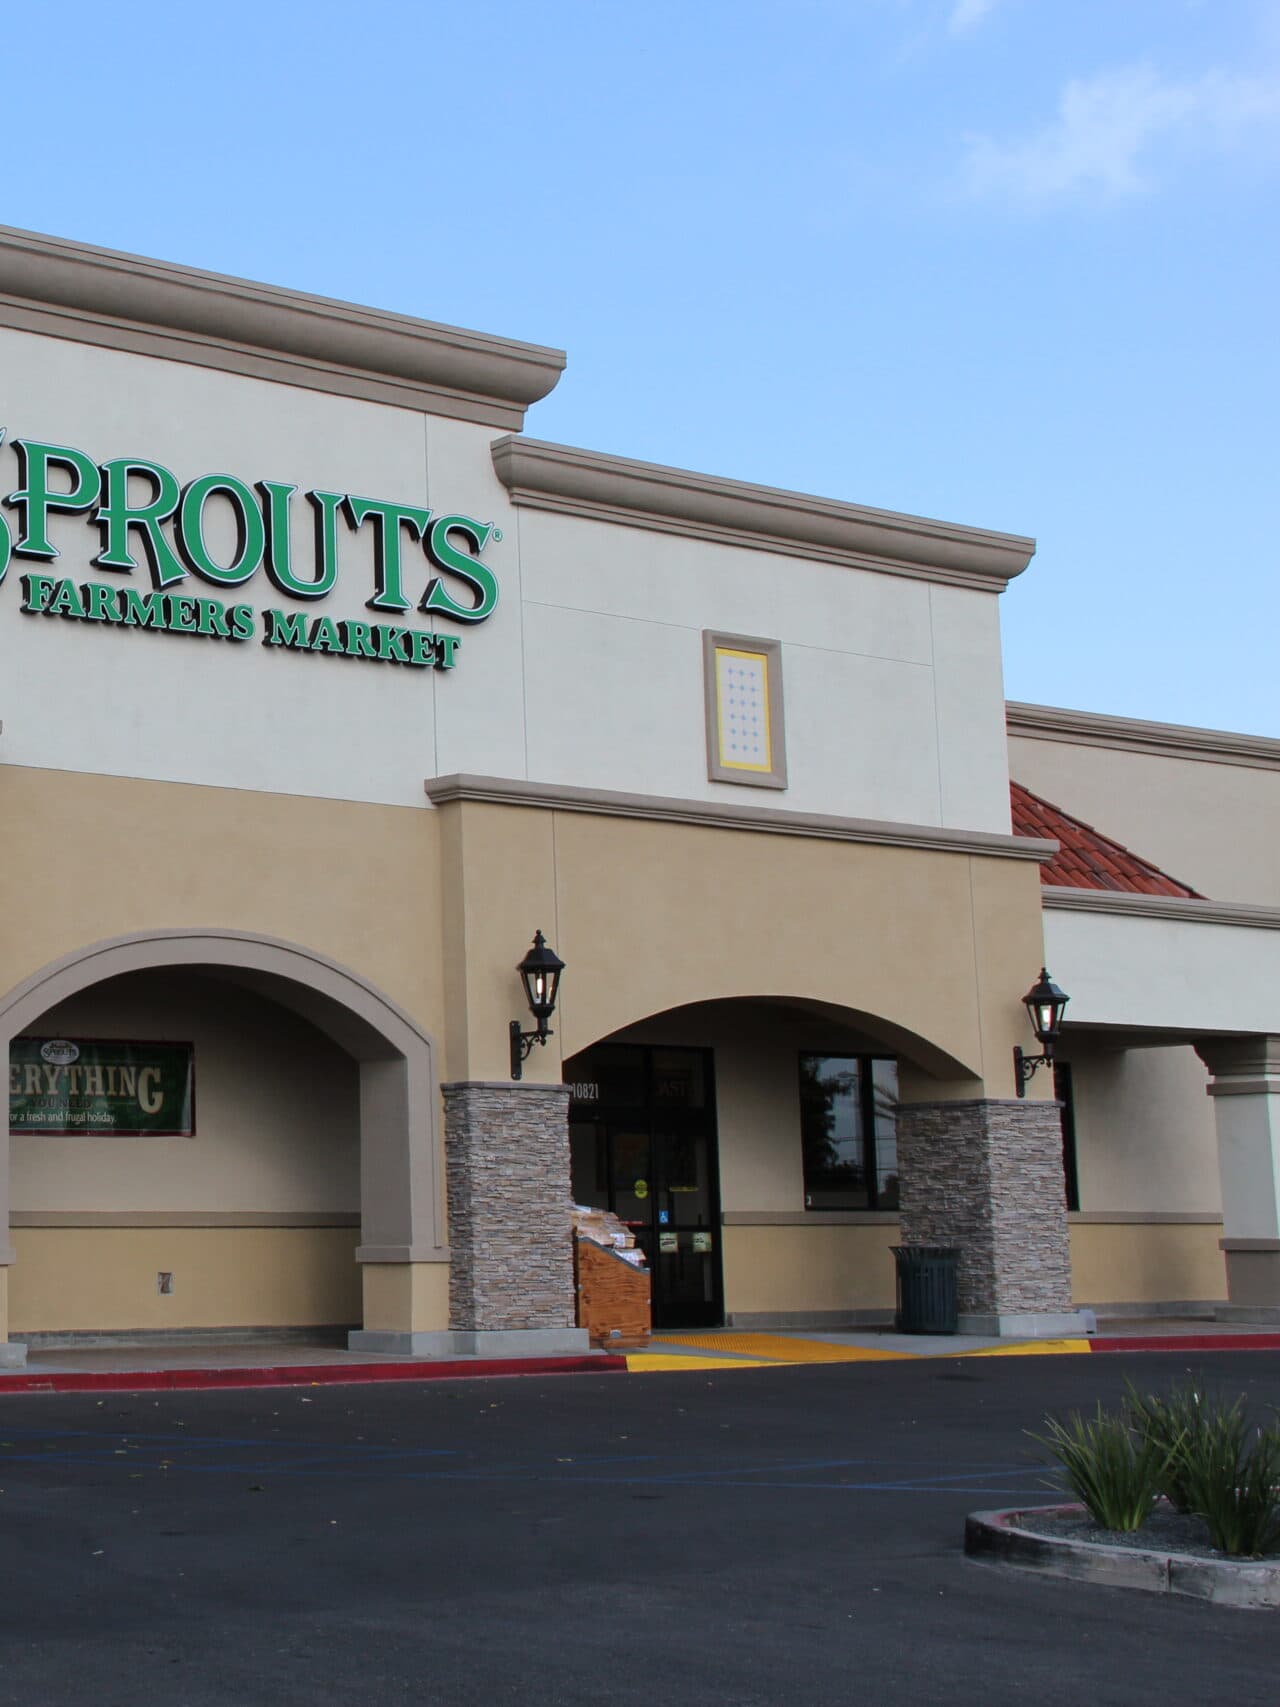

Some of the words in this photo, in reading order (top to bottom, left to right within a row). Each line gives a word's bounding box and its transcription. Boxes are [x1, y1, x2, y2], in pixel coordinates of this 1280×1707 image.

[21, 572, 255, 642] FARMERS
[265, 608, 462, 672] MARKET
[571, 1082, 599, 1099] 10821
[31, 1099, 55, 1109] YOU
[26, 1112, 47, 1123] fresh
[48, 1112, 64, 1123] and
[65, 1112, 87, 1126] frugal
